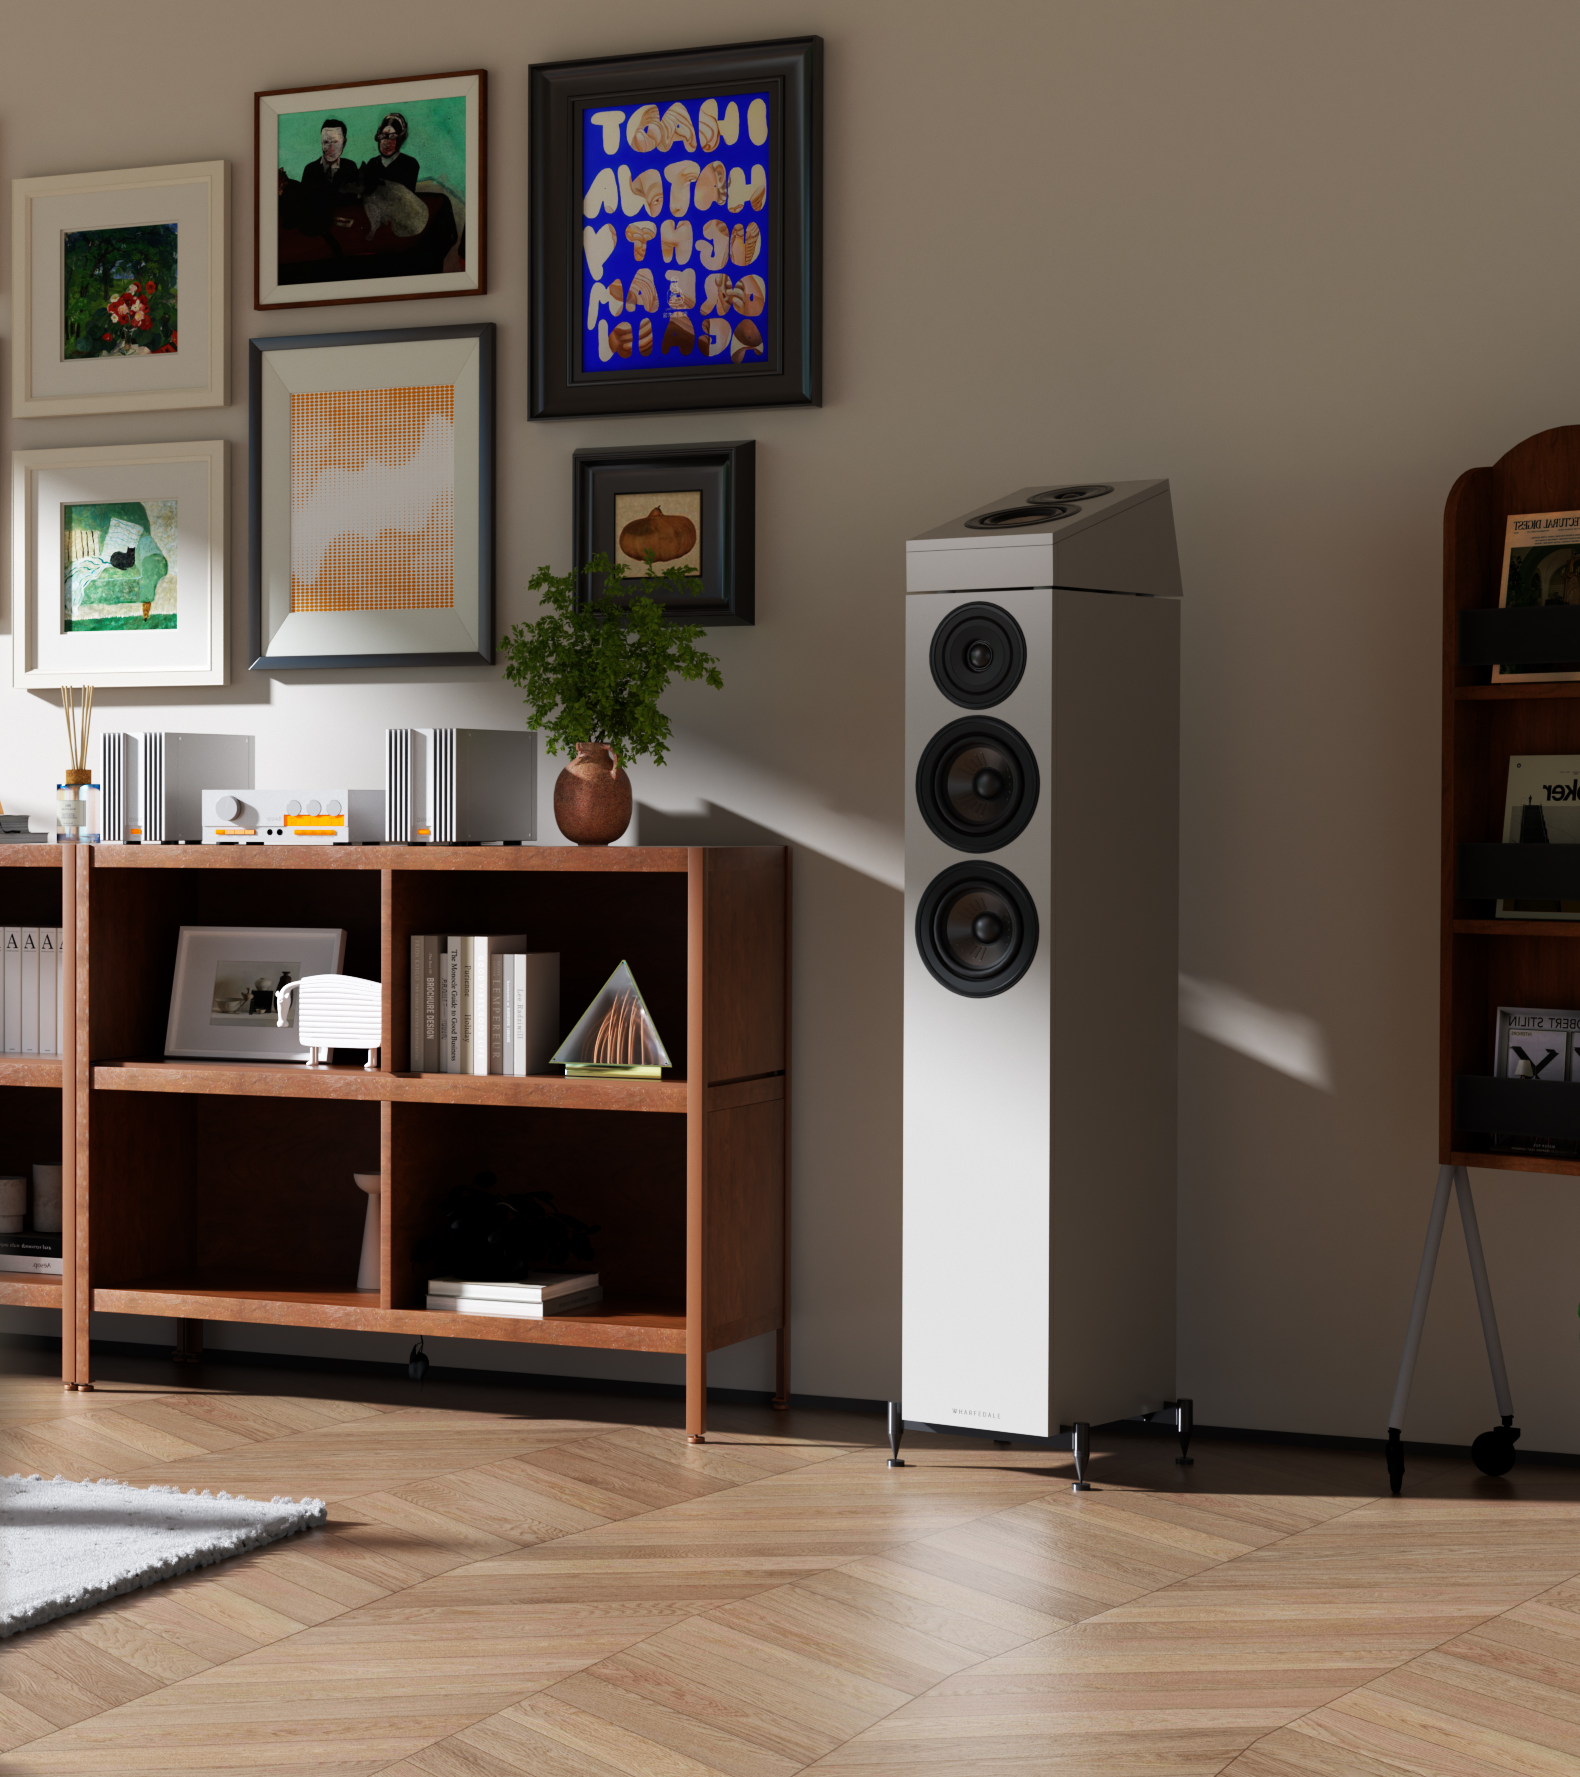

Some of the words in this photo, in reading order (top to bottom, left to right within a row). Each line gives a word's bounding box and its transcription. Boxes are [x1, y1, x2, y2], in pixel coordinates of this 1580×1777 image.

[6, 933, 18, 949] A
[24, 934, 36, 949] A
[42, 934, 54, 950] A
[464, 965, 472, 997] Purienne
[427, 977, 435, 1013] BROCHURE
[427, 1015, 435, 1039] DESIGN
[462, 1014, 472, 1043] Holiday
[492, 980, 501, 1059] LEMPEREUR
[951, 1408, 1001, 1419] WHARFEDALE
